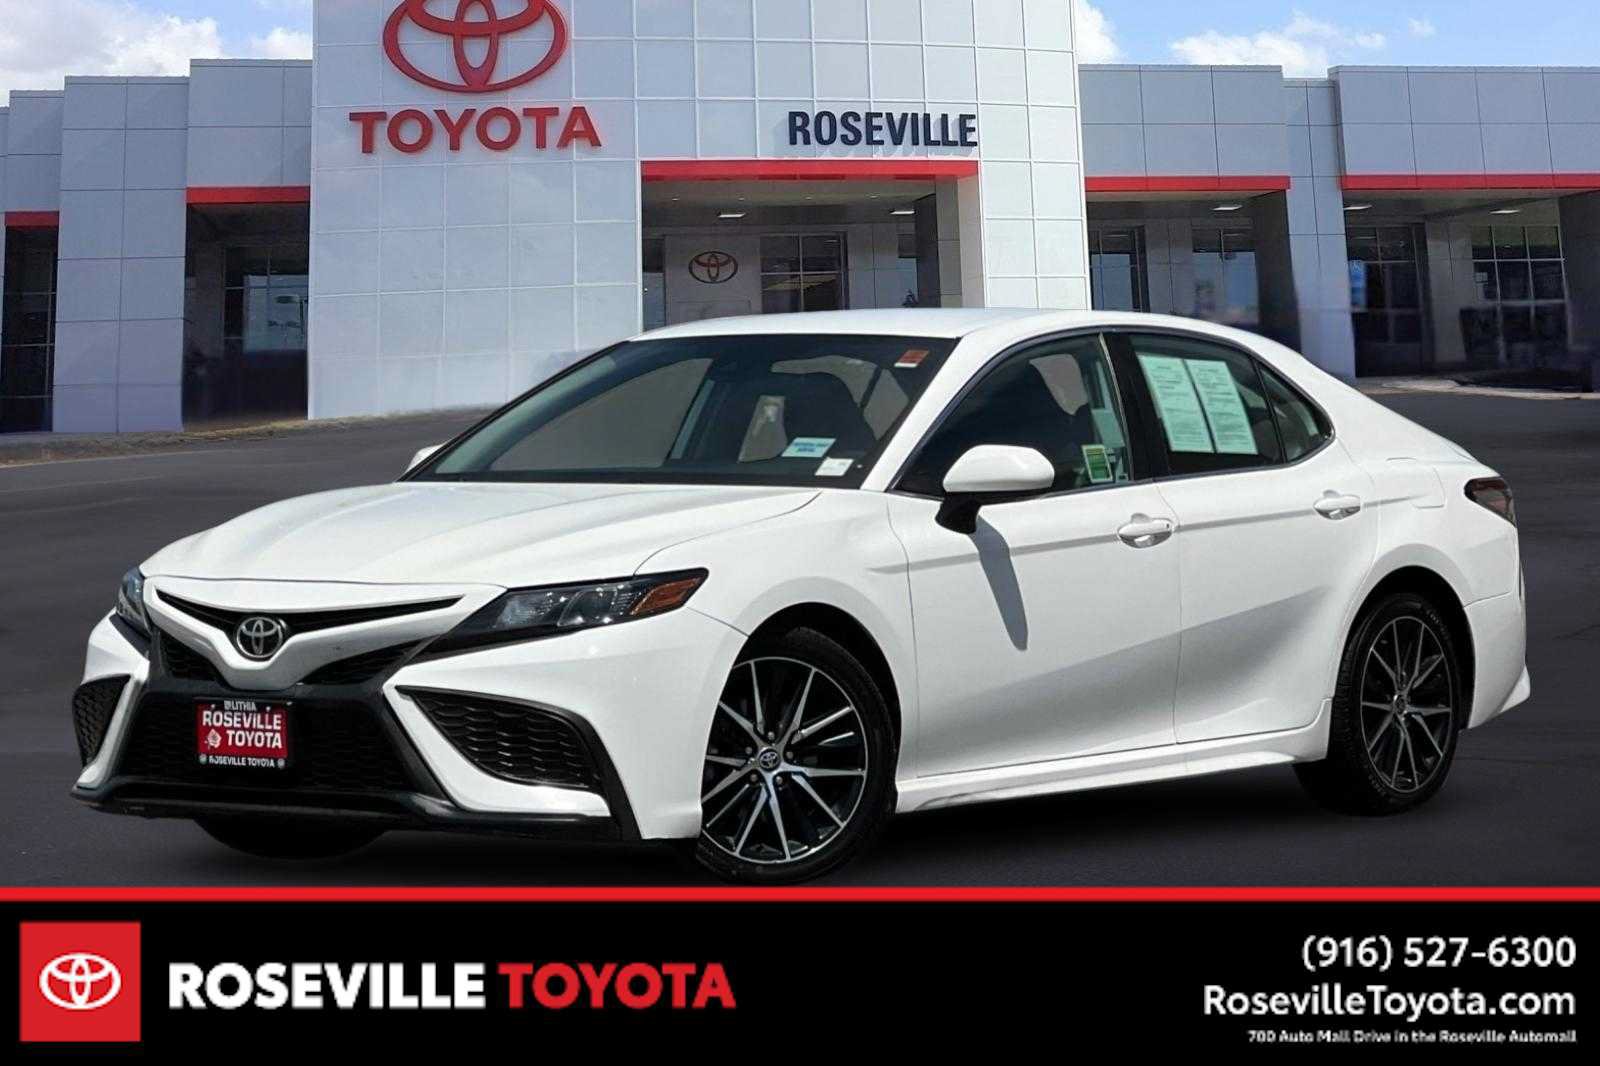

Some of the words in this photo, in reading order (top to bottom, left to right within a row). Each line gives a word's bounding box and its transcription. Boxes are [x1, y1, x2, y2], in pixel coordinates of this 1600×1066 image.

[349, 106, 602, 154] TOYOTA
[788, 110, 978, 147] ROSEVILLE
[202, 710, 282, 730] ROSEVILLE
[226, 729, 283, 749] TOYOTA
[208, 755, 247, 766] ROSEVILLE
[247, 757, 275, 768] TOYOTA
